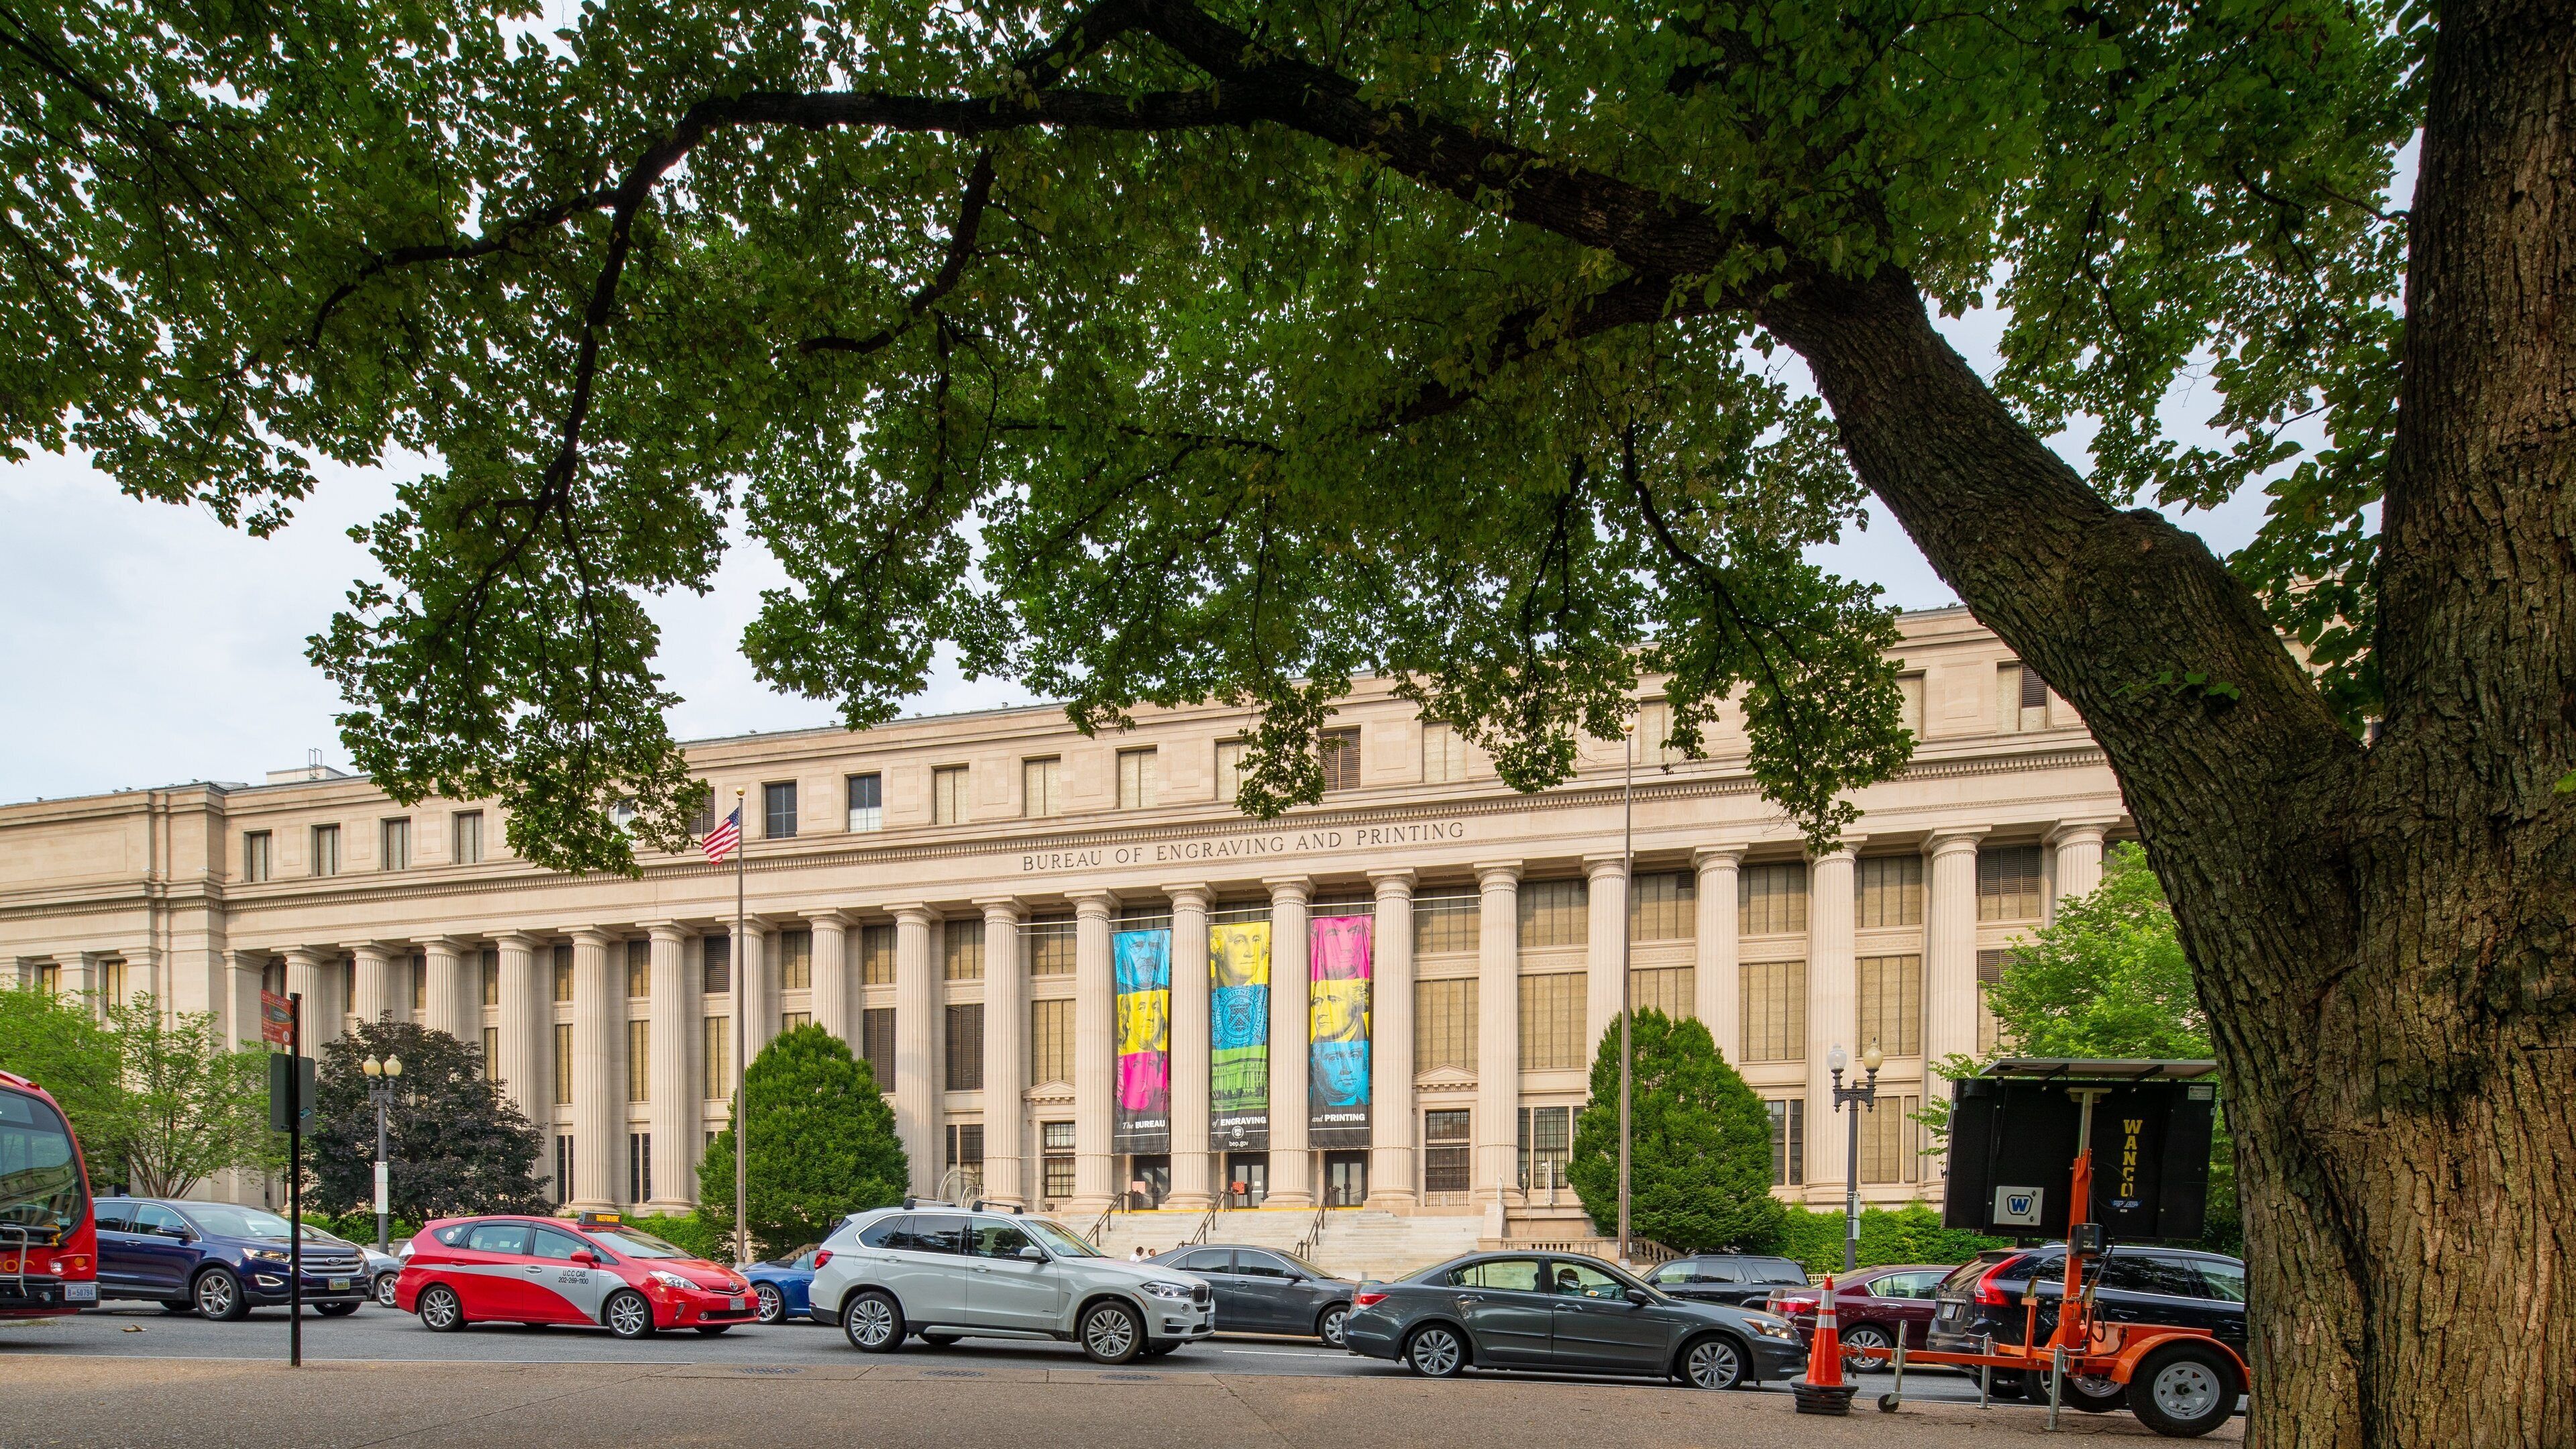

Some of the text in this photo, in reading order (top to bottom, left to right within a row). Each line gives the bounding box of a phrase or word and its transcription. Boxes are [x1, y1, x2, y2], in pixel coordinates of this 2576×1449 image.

[1022, 822, 1464, 871] BUREAU OF ENGRAVING AND PRINTING
[1212, 1116, 1267, 1128] of ENGRAVING
[1311, 1113, 1366, 1122] and PRINTING
[1135, 1120, 1165, 1129] BUREAU
[2121, 1119, 2143, 1197] WANCO
[2010, 1198, 2029, 1212] W
[558, 1277, 589, 1285] 202-269-1100
